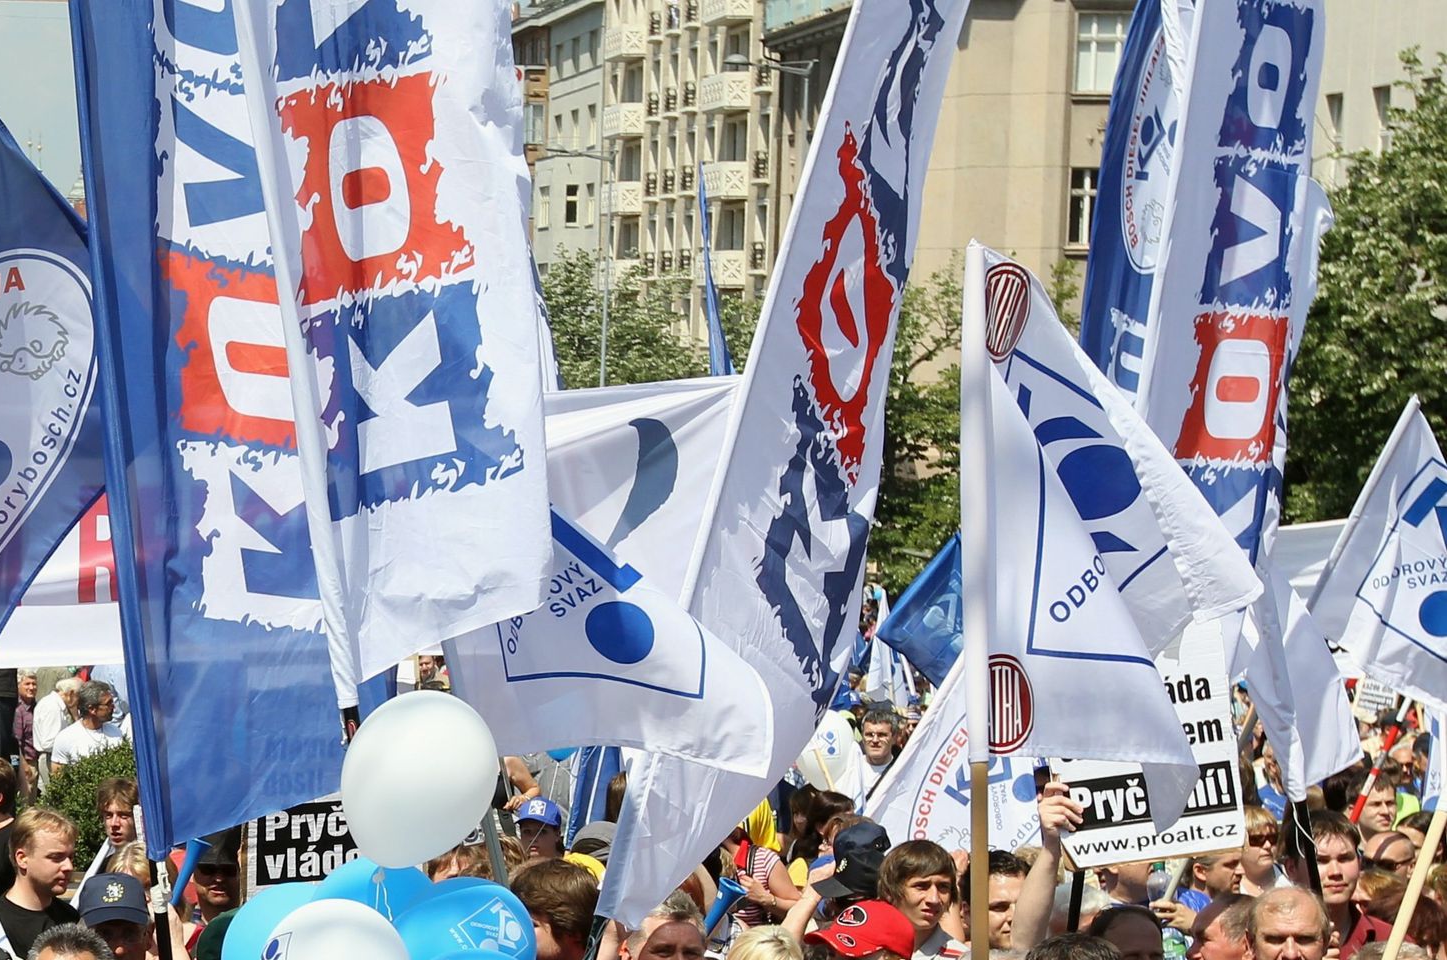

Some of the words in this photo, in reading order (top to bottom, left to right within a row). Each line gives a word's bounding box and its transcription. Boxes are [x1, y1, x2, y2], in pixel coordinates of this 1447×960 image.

[1125, 113, 1142, 178] DIESEL
[1124, 185, 1139, 249] BOSCH
[549, 578, 604, 618] SVAZ
[1069, 777, 1148, 823] Pryč
[265, 805, 349, 843] Pryč
[1072, 823, 1238, 856] www.proalt.cz
